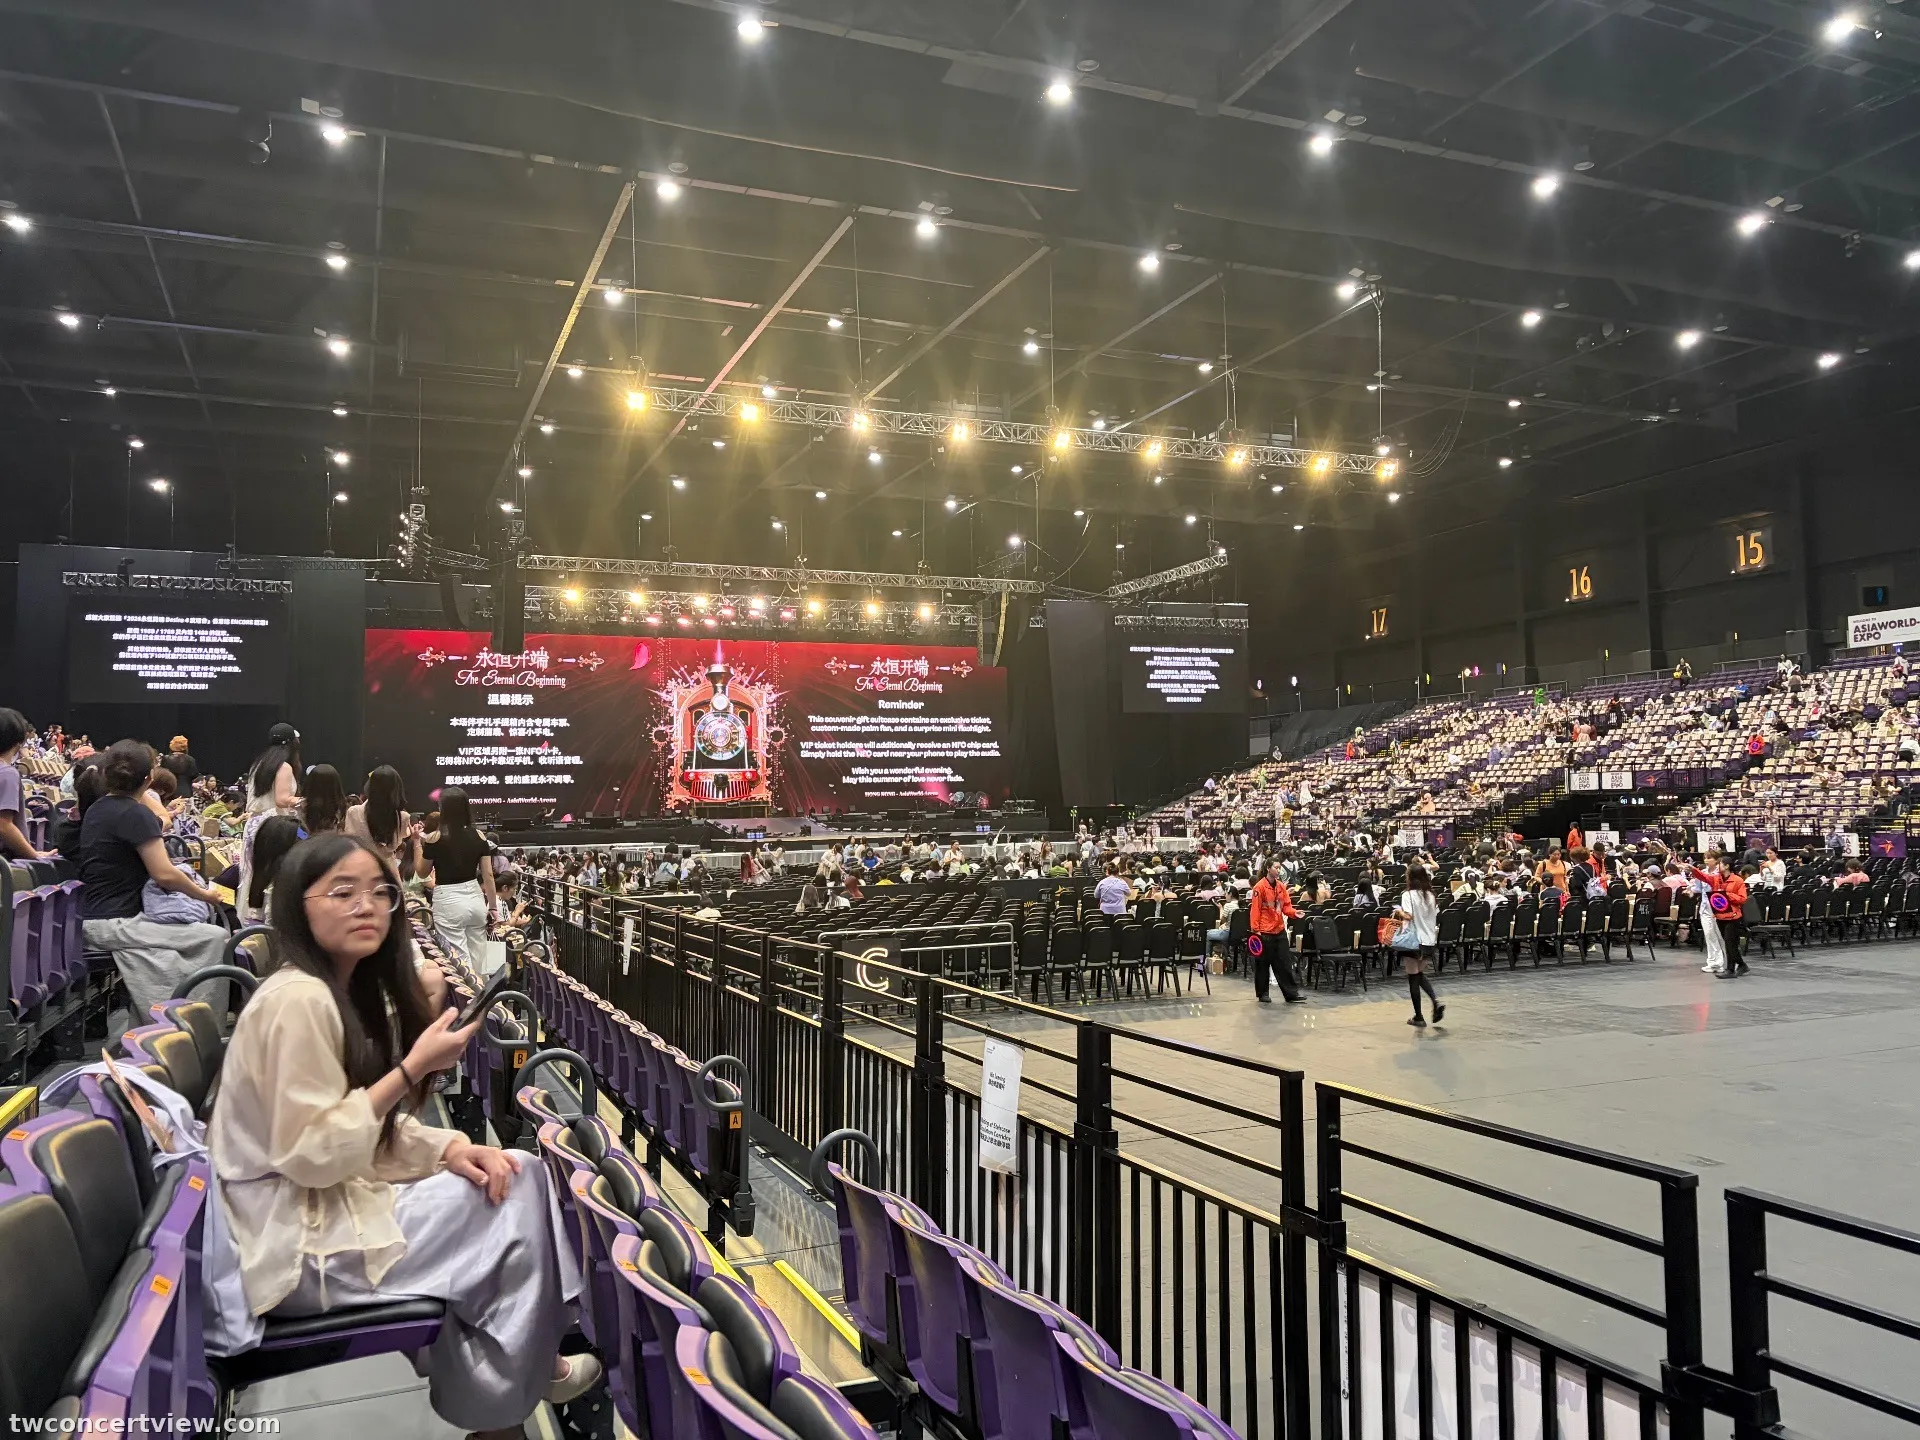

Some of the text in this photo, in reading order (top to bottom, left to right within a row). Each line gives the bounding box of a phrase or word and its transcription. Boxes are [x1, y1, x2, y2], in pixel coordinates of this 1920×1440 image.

[1736, 532, 1763, 566] 15
[1569, 566, 1592, 595] 16
[1371, 608, 1387, 633] 17
[1853, 617, 1920, 634] ASIAWORLD-
[1853, 631, 1882, 643] EXPO
[473, 646, 550, 672] 永恒开端
[868, 656, 930, 679] 永恒开端
[455, 669, 566, 688] The Eternal Beginning
[854, 677, 874, 692] The
[903, 678, 943, 694] Beginning
[487, 694, 534, 706] 温馨提示
[878, 700, 925, 710] Reminder
[856, 947, 889, 992] C
[517, 1053, 524, 1065] B
[732, 1114, 739, 1126] A
